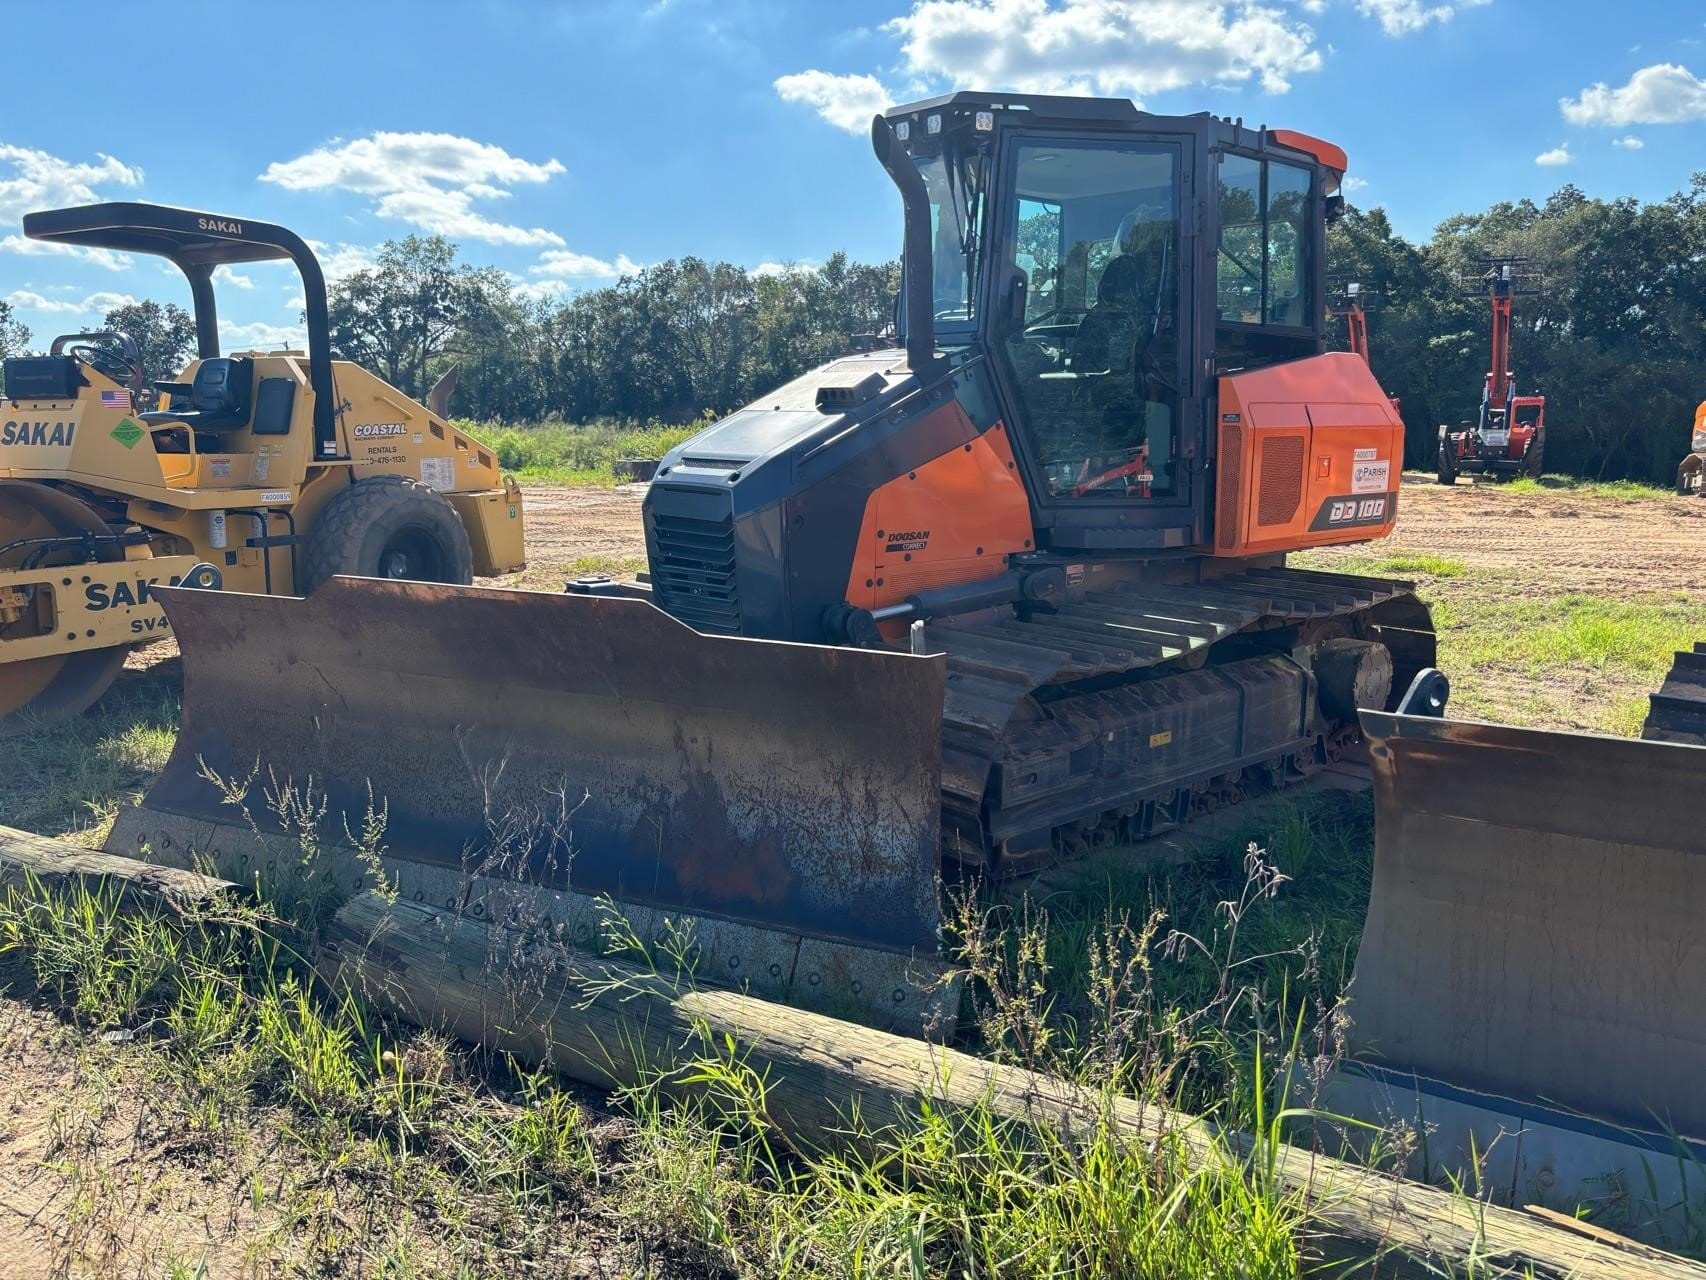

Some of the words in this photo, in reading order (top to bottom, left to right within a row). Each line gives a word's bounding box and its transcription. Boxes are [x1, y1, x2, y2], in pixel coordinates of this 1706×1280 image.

[198, 218, 242, 234] SAKAI
[2, 421, 75, 446] SAKAI
[354, 423, 407, 436] COASTAL
[368, 446, 397, 454] RENTALS
[360, 455, 406, 466] 3-476-1130
[1357, 499, 1385, 520] 100
[888, 531, 930, 542] DOOSAN
[131, 616, 169, 633] SV4
